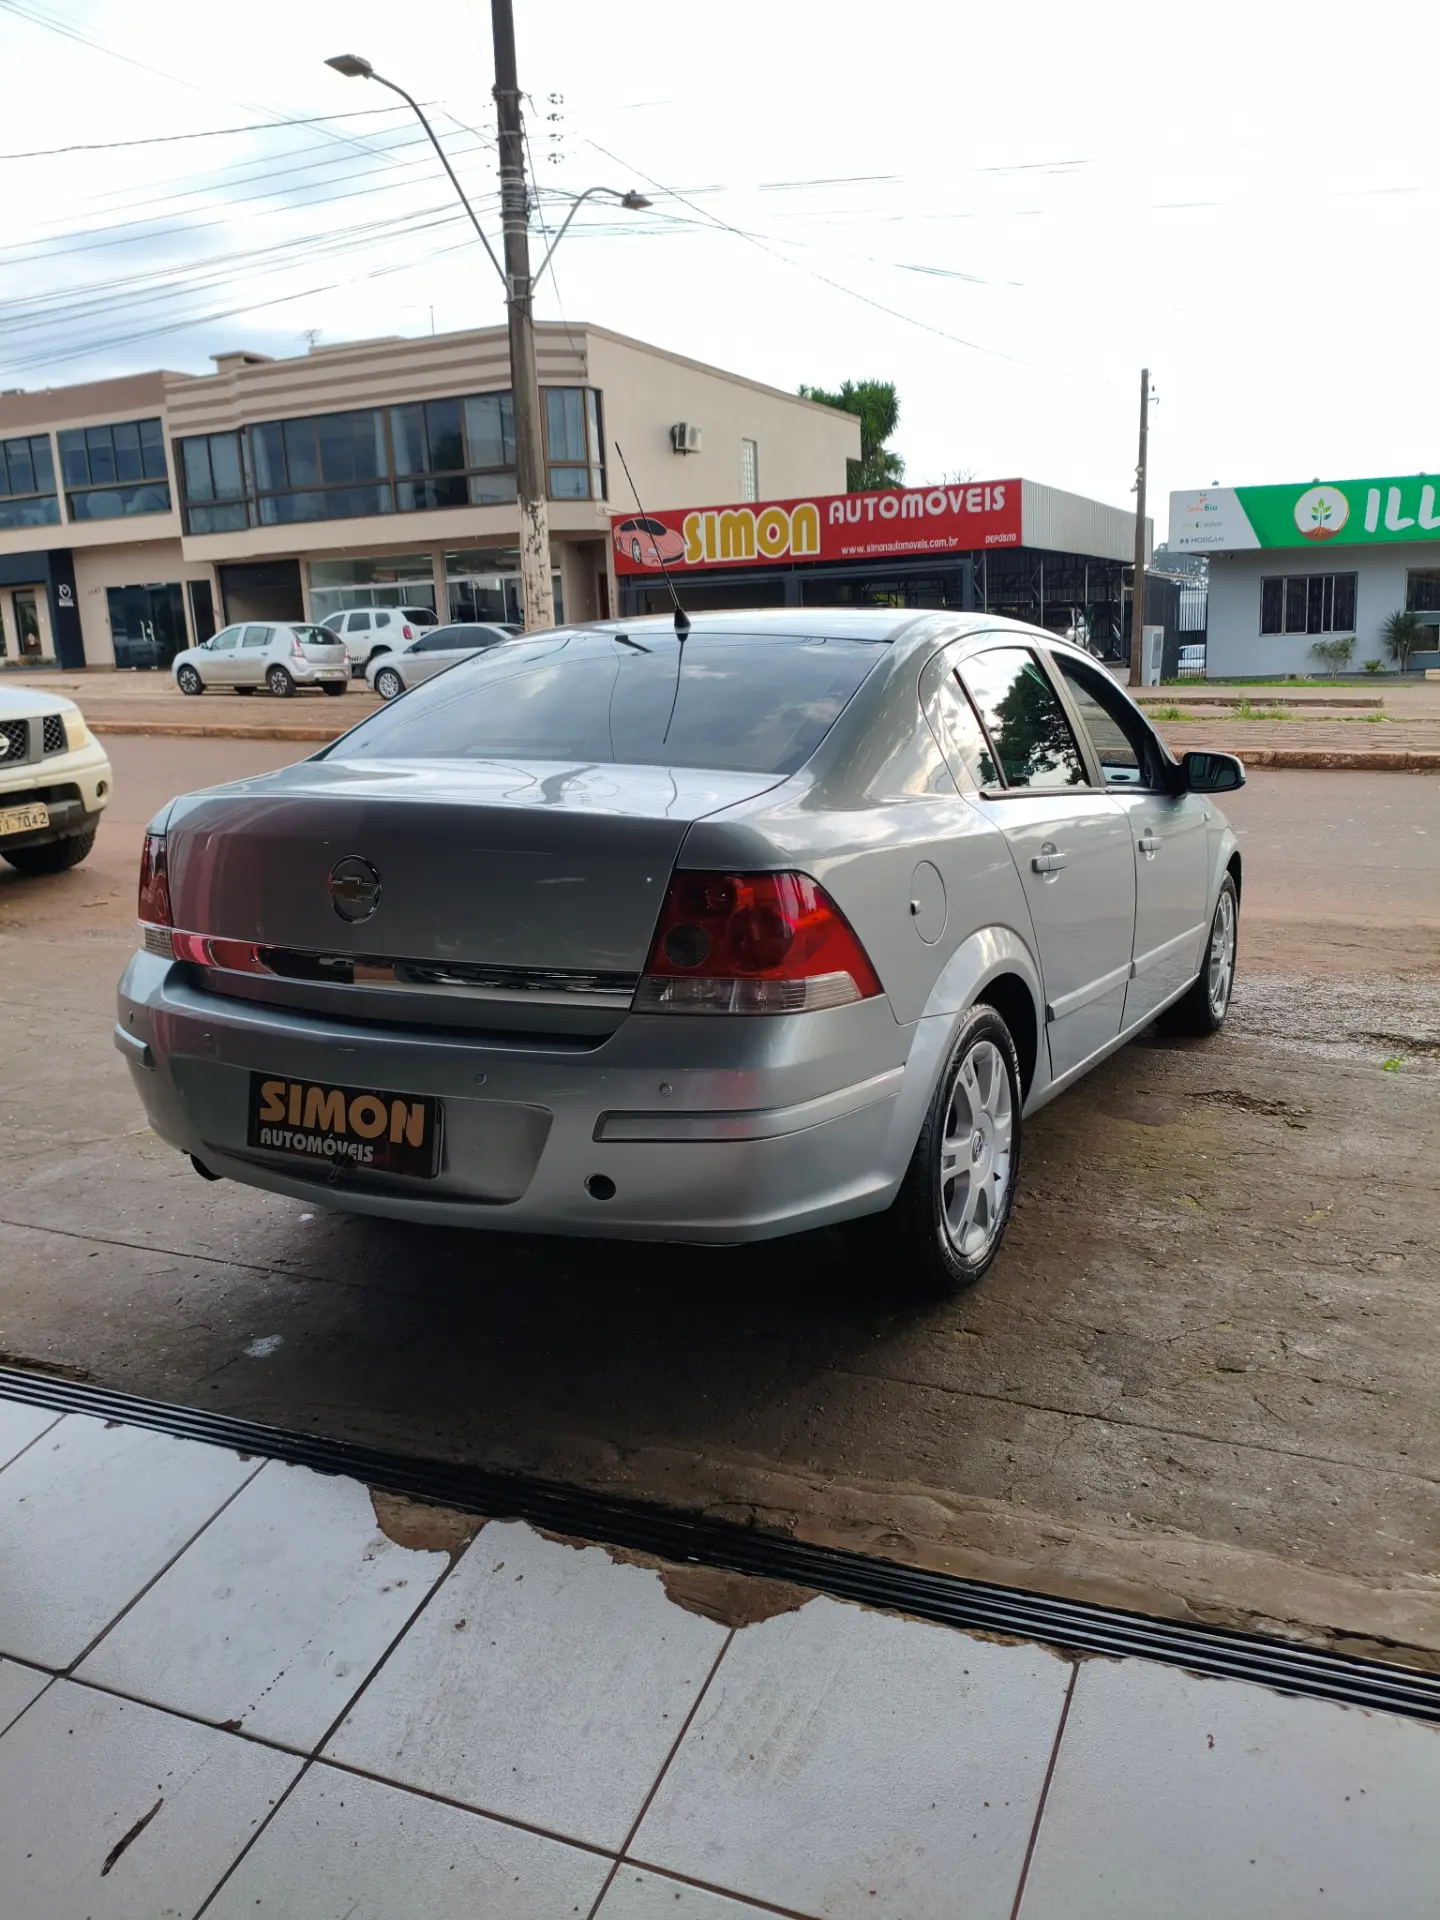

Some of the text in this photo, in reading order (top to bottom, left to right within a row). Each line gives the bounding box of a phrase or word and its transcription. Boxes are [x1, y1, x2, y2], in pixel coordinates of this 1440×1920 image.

[829, 484, 1006, 525] AUTOMÓVEIS
[682, 502, 820, 564] SIMON
[259, 1080, 425, 1147] SIMON
[260, 1127, 374, 1163] AUTOMÓVEIS
